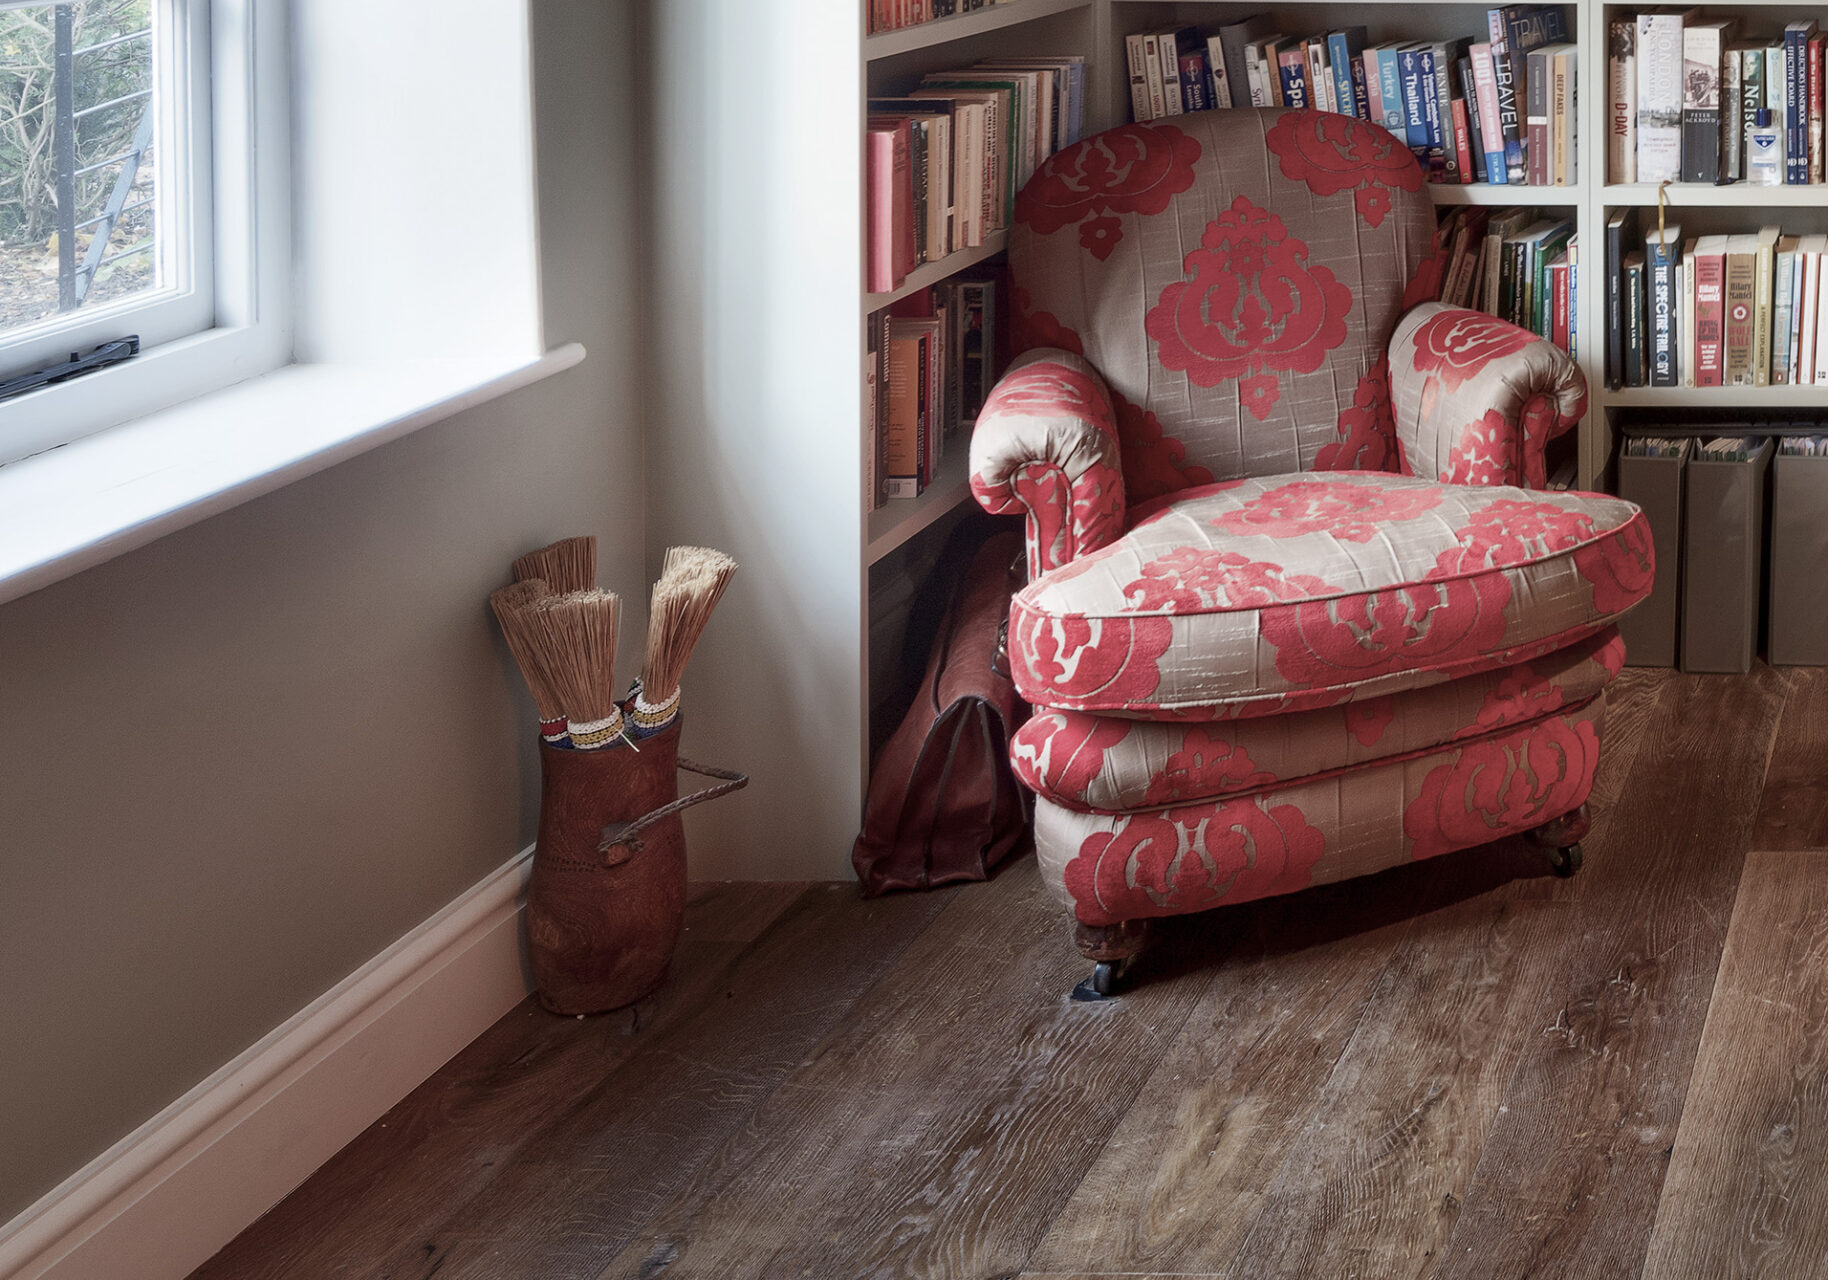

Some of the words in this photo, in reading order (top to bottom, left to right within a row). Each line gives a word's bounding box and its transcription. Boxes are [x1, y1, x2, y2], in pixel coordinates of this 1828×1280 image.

[1368, 73, 1379, 96] Syria
[1383, 61, 1396, 99] Turkey
[1556, 74, 1564, 93] DEEP
[1658, 30, 1673, 101] LONDON
[1405, 73, 1422, 126] Thailand
[1436, 65, 1449, 107] VENICE
[1496, 59, 1518, 136] TRAVEL
[1556, 94, 1564, 115] FAKES
[1615, 102, 1628, 137] D-DAY
[1457, 128, 1466, 151] WALES
[1656, 266, 1669, 283] THE
[1655, 284, 1668, 331] SPECTRE
[1655, 332, 1668, 375] TRILOGY
